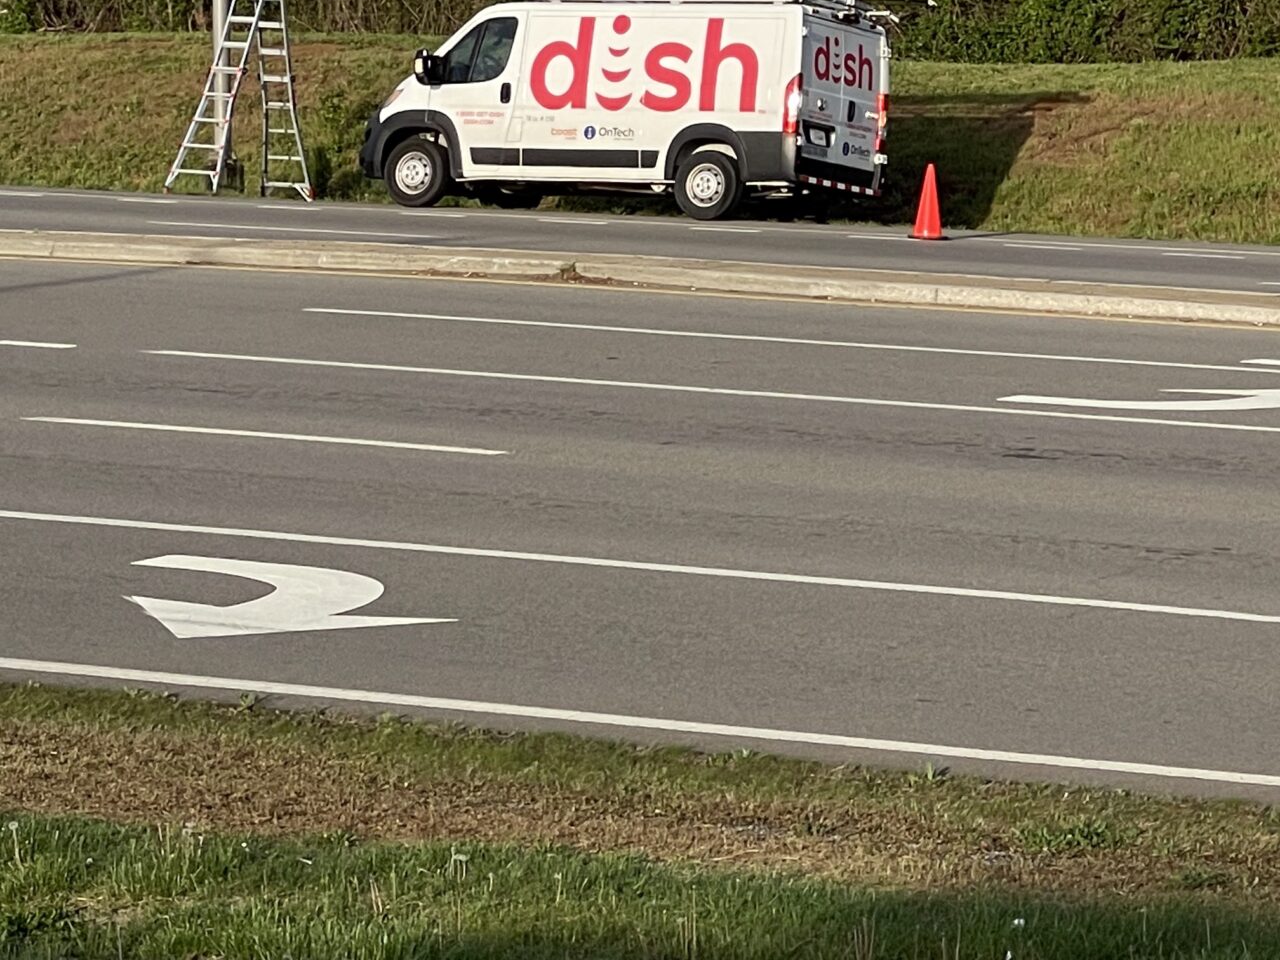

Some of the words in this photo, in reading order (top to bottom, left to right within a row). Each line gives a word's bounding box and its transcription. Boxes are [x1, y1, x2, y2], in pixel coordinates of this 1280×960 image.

[530, 14, 760, 113] dish
[814, 36, 874, 91] dish
[598, 126, 635, 137] OnTech
